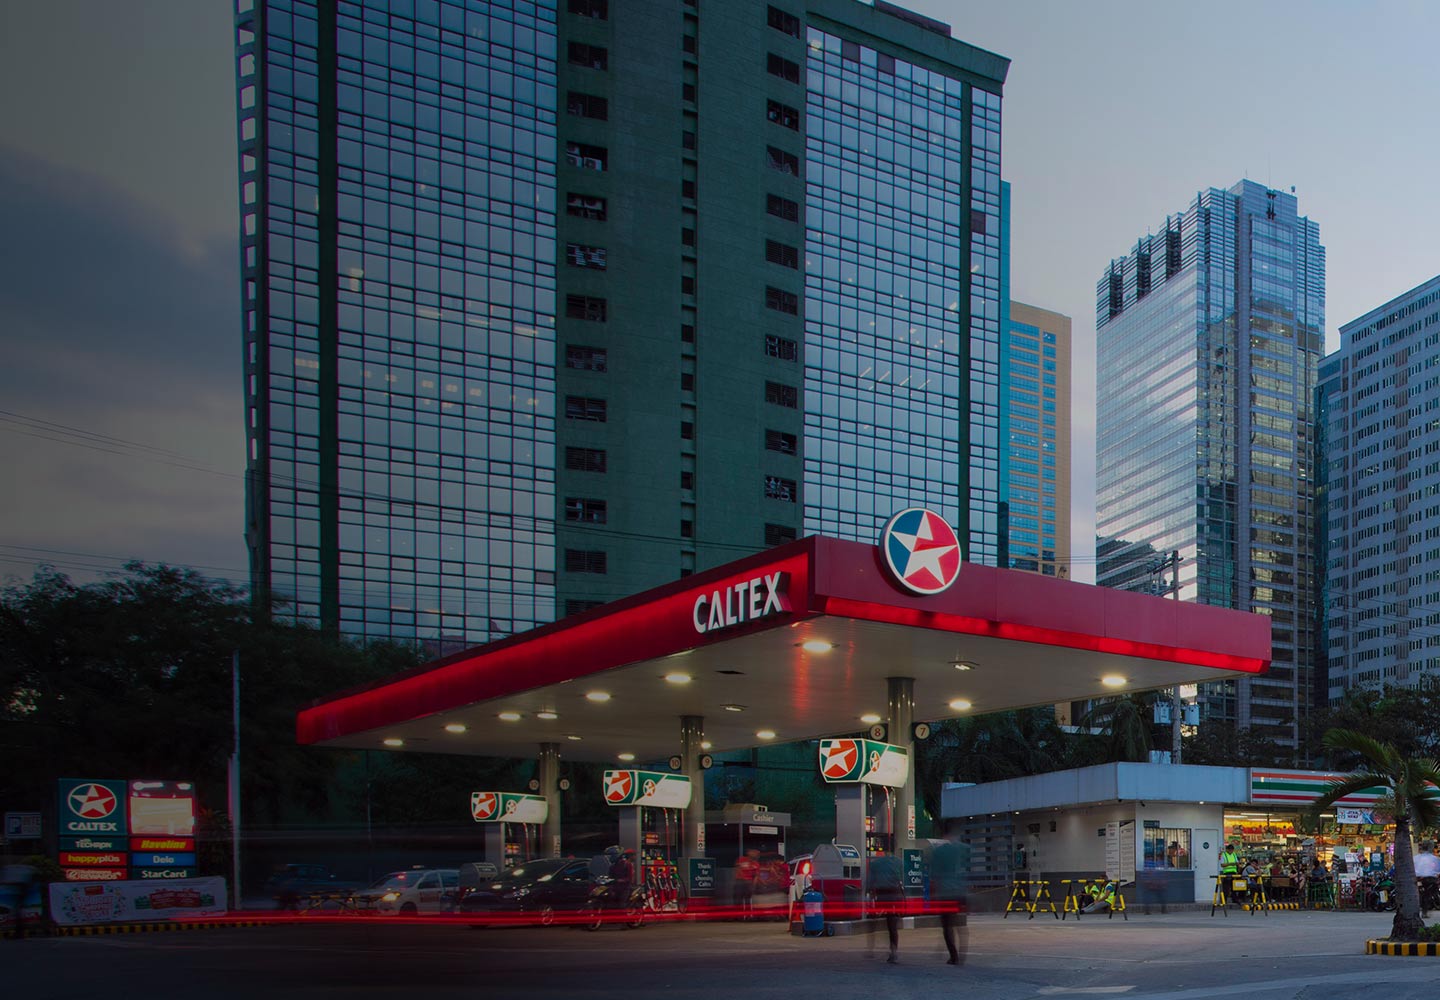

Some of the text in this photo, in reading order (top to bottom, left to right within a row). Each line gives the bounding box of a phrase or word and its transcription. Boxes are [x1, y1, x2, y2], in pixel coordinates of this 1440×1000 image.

[693, 571, 783, 634] CALTEX
[874, 728, 881, 737] 8
[920, 728, 926, 736] 7
[752, 814, 774, 822] Cashier
[67, 822, 118, 832] CALTEX
[141, 840, 187, 849] Havoline
[153, 856, 174, 864] Delo
[141, 869, 187, 879] StarCard
